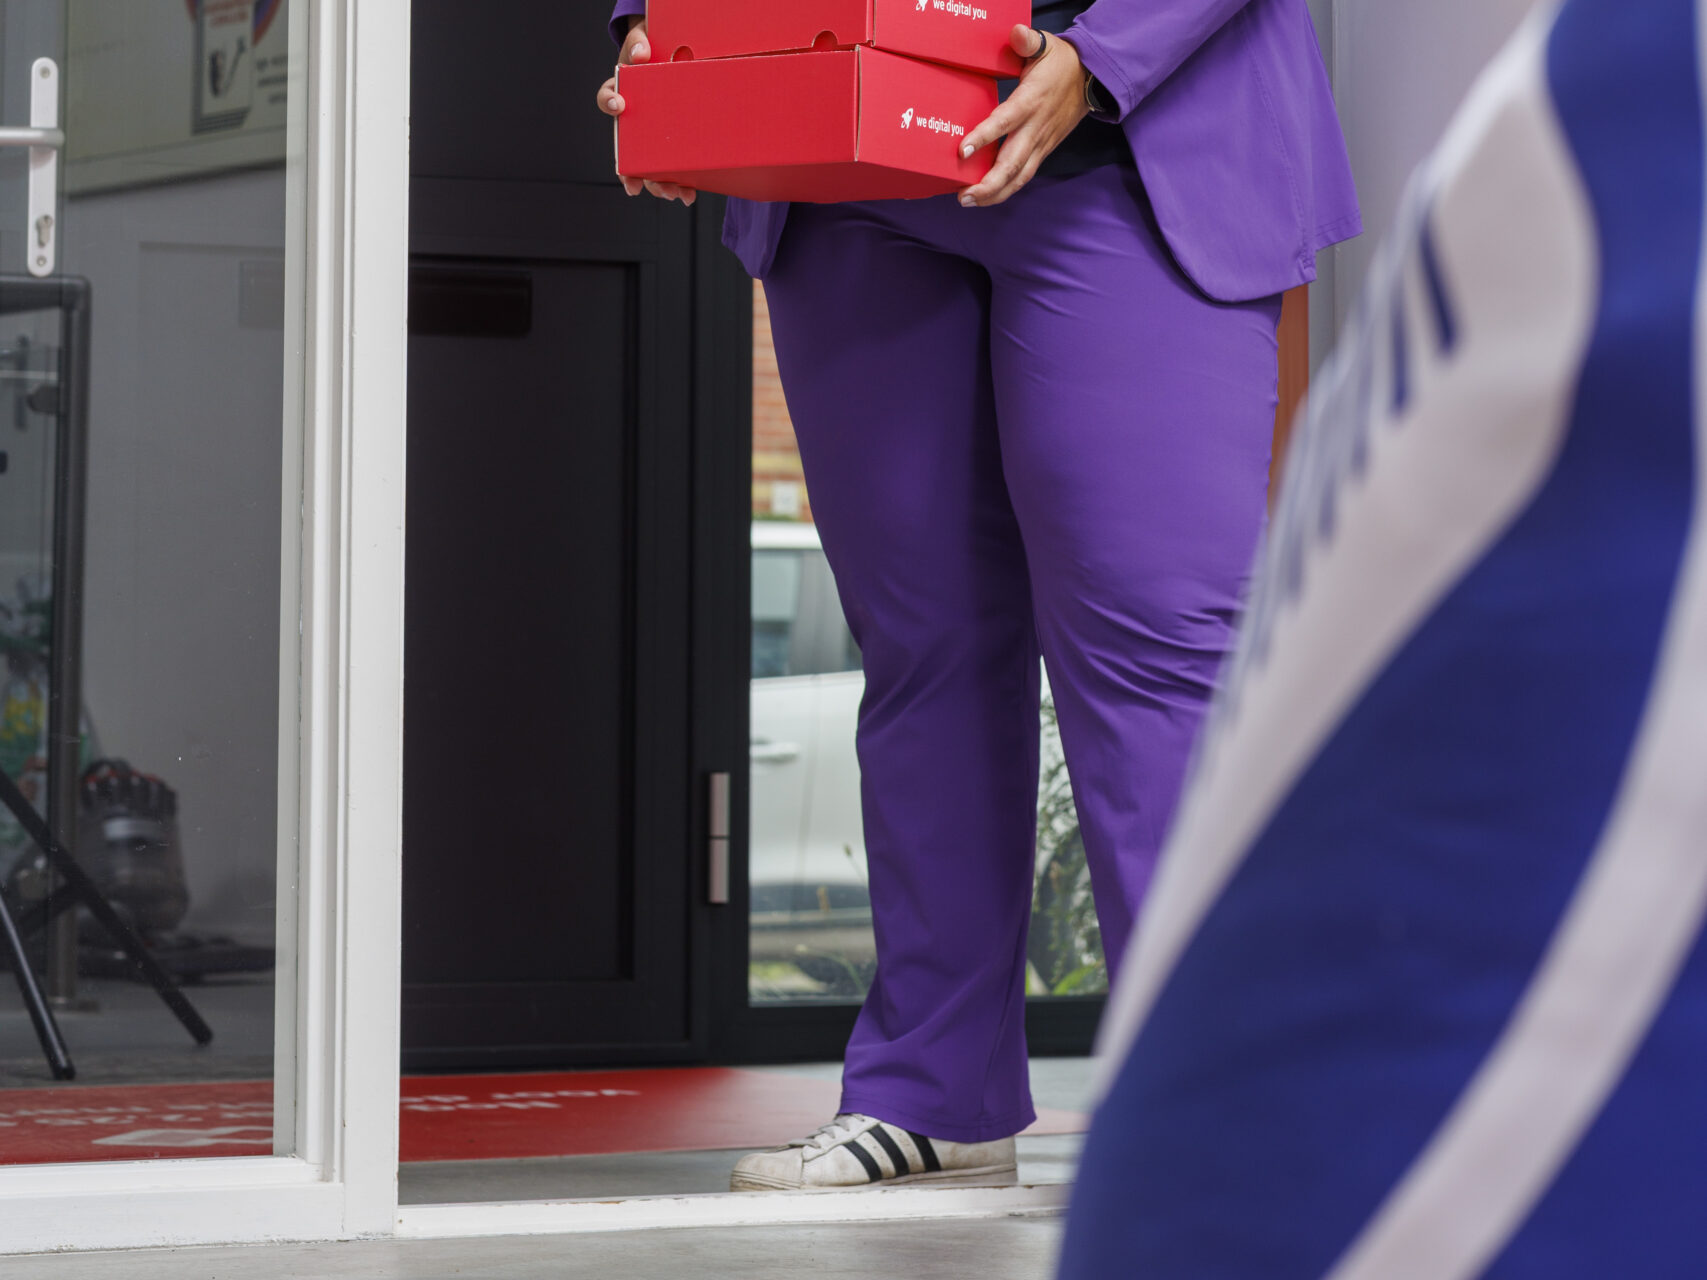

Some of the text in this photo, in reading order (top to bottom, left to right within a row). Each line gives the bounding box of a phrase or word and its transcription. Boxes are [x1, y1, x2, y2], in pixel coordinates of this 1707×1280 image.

[932, 0, 987, 21] we digital you
[916, 116, 965, 137] we digital you
